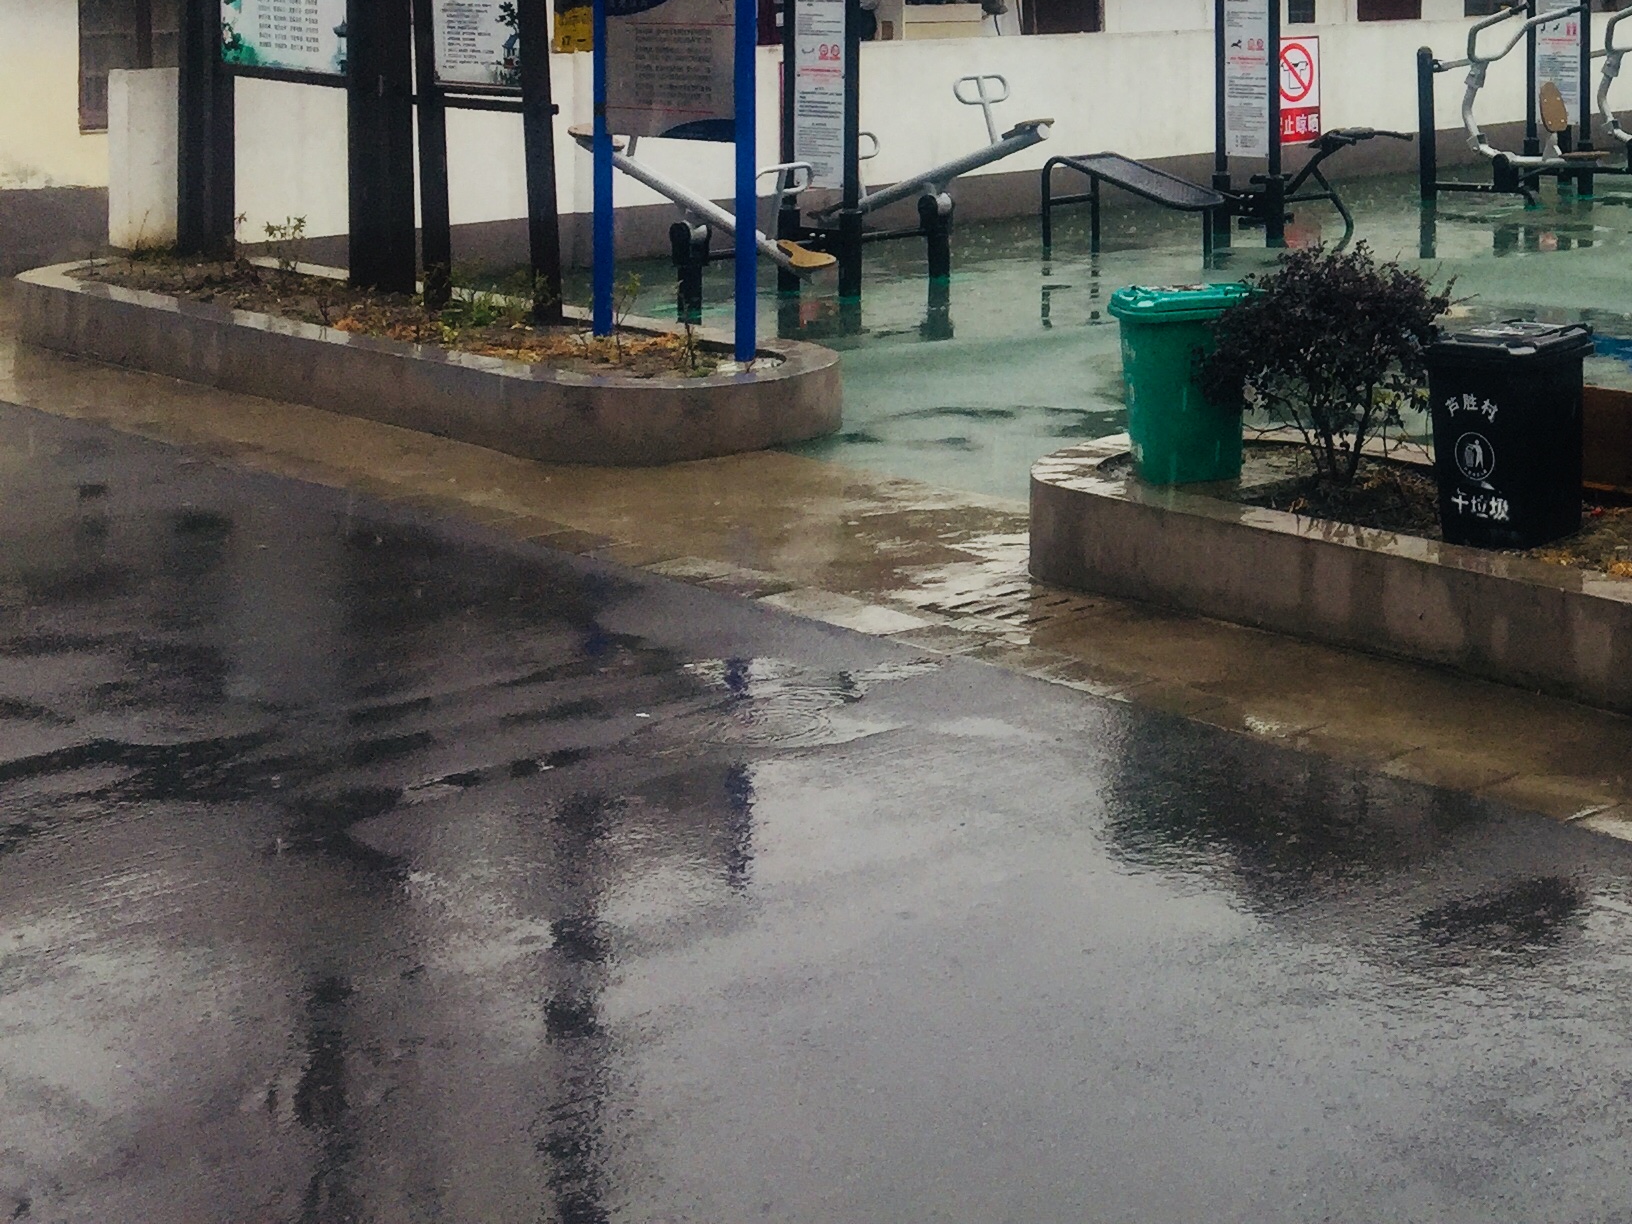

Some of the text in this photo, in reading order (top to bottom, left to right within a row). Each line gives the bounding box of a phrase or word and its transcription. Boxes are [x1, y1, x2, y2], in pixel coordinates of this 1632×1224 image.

[1280, 113, 1319, 135] 止晾晒
[1444, 393, 1499, 424] 芦胜村
